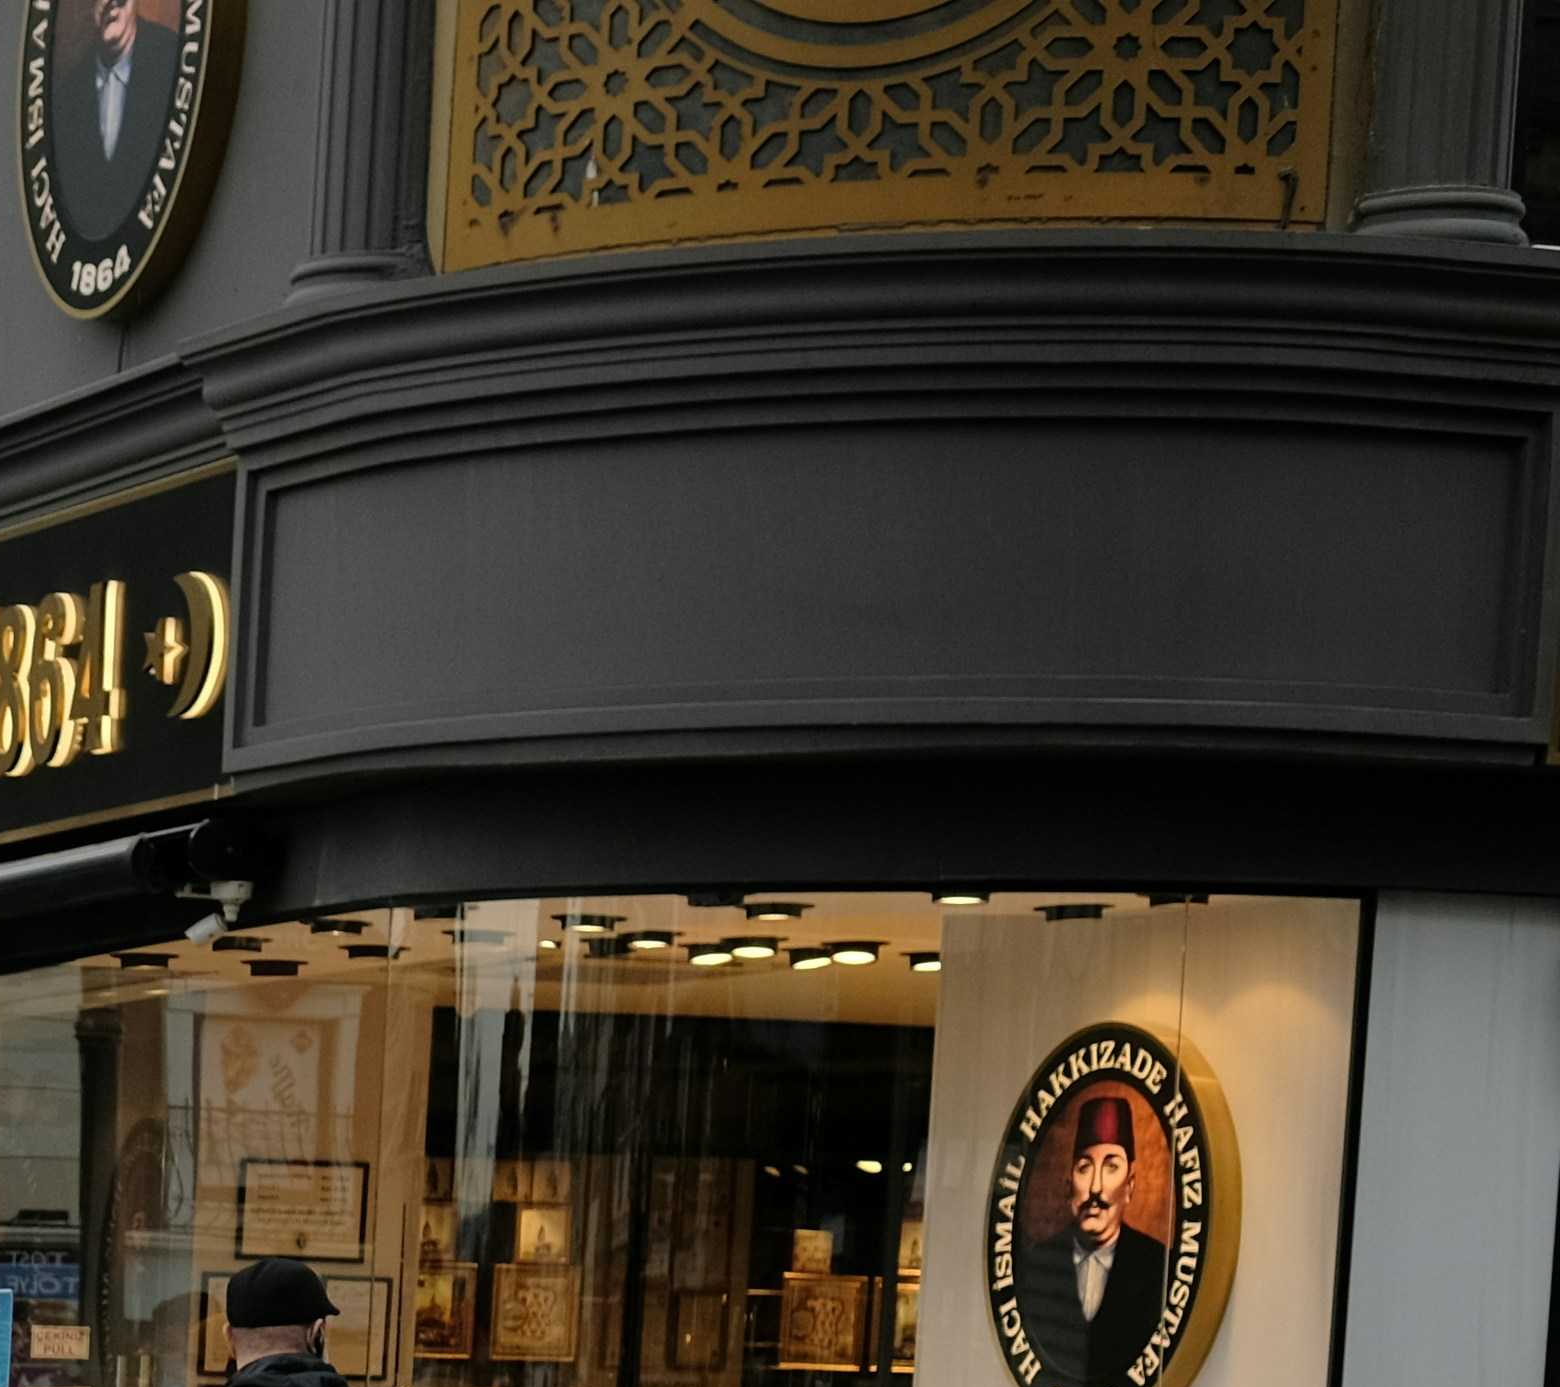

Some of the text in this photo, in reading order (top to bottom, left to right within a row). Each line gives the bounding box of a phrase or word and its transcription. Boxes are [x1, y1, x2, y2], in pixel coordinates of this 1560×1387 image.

[30, 156, 67, 266] HACI
[70, 243, 132, 297] 1864
[991, 1155, 1027, 1291] İSMAİL
[999, 1296, 1042, 1385] HACI
[1126, 1219, 1204, 1387] MUSTAFA
